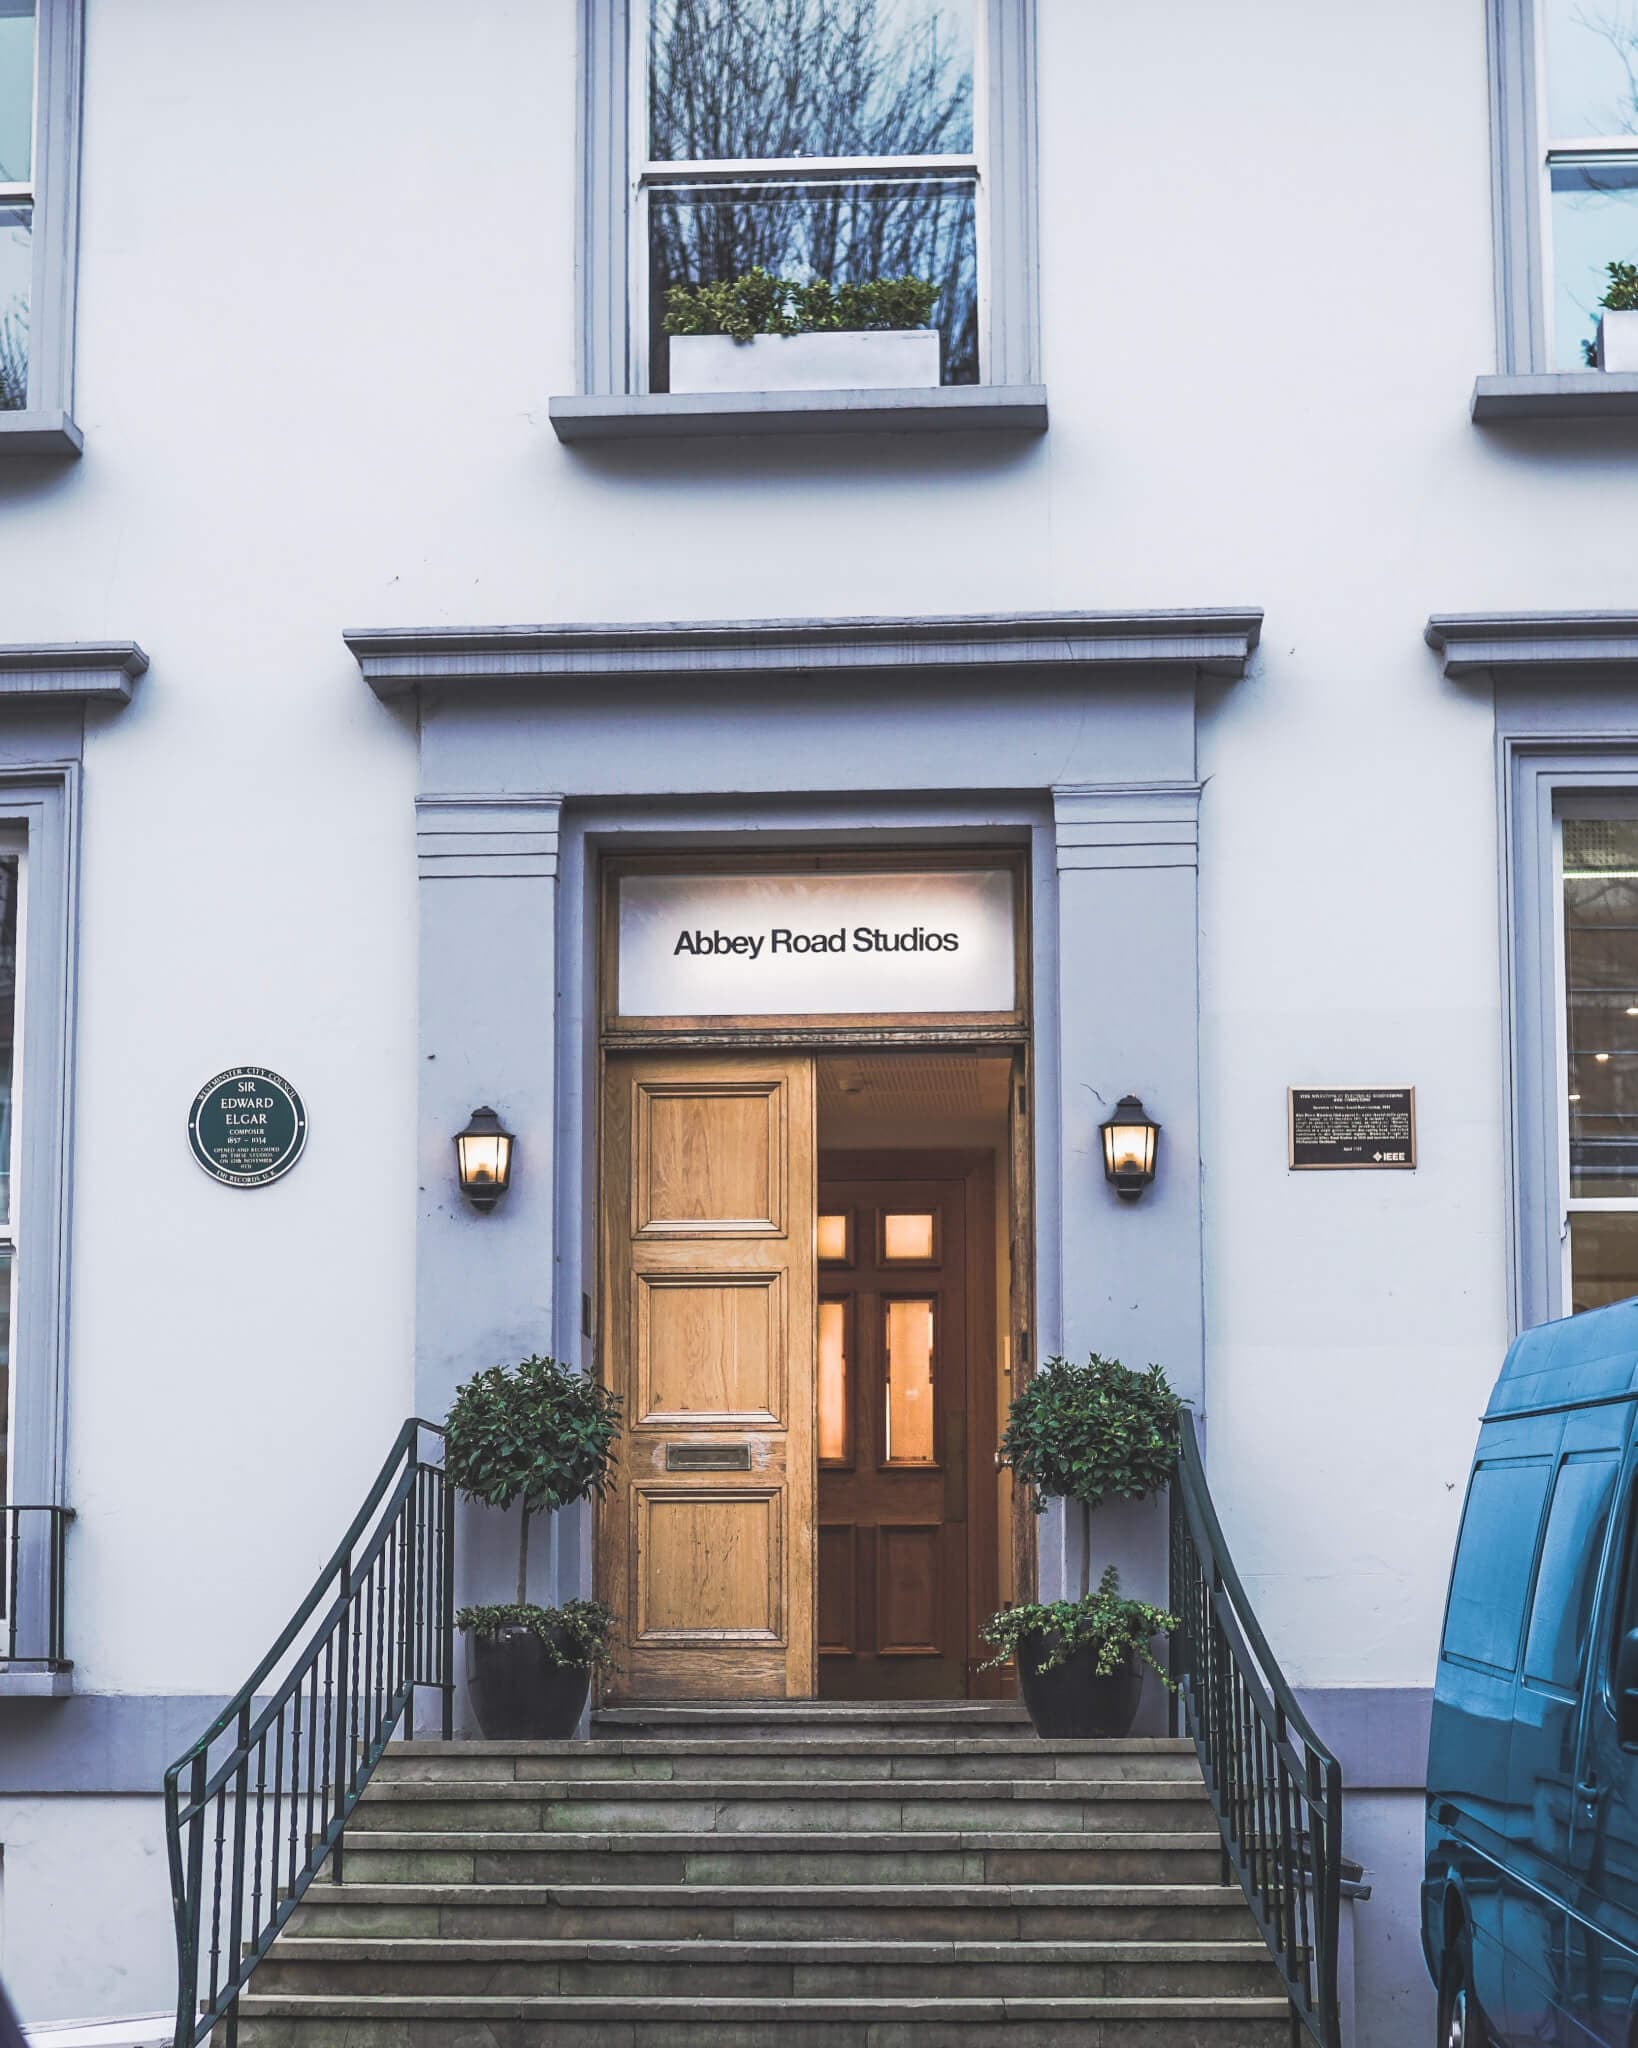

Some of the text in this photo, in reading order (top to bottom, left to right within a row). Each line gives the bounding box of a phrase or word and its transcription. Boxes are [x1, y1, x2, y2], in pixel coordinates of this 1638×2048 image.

[673, 927, 959, 960] Abbey Road Studios
[197, 1068, 242, 1101] WESTMINSTER
[268, 1072, 297, 1099] COUNCIL
[238, 1082, 256, 1092] SIR
[221, 1098, 274, 1109] EDWARD
[225, 1114, 267, 1125] ELGAR
[1383, 1152, 1405, 1161] IEEE
